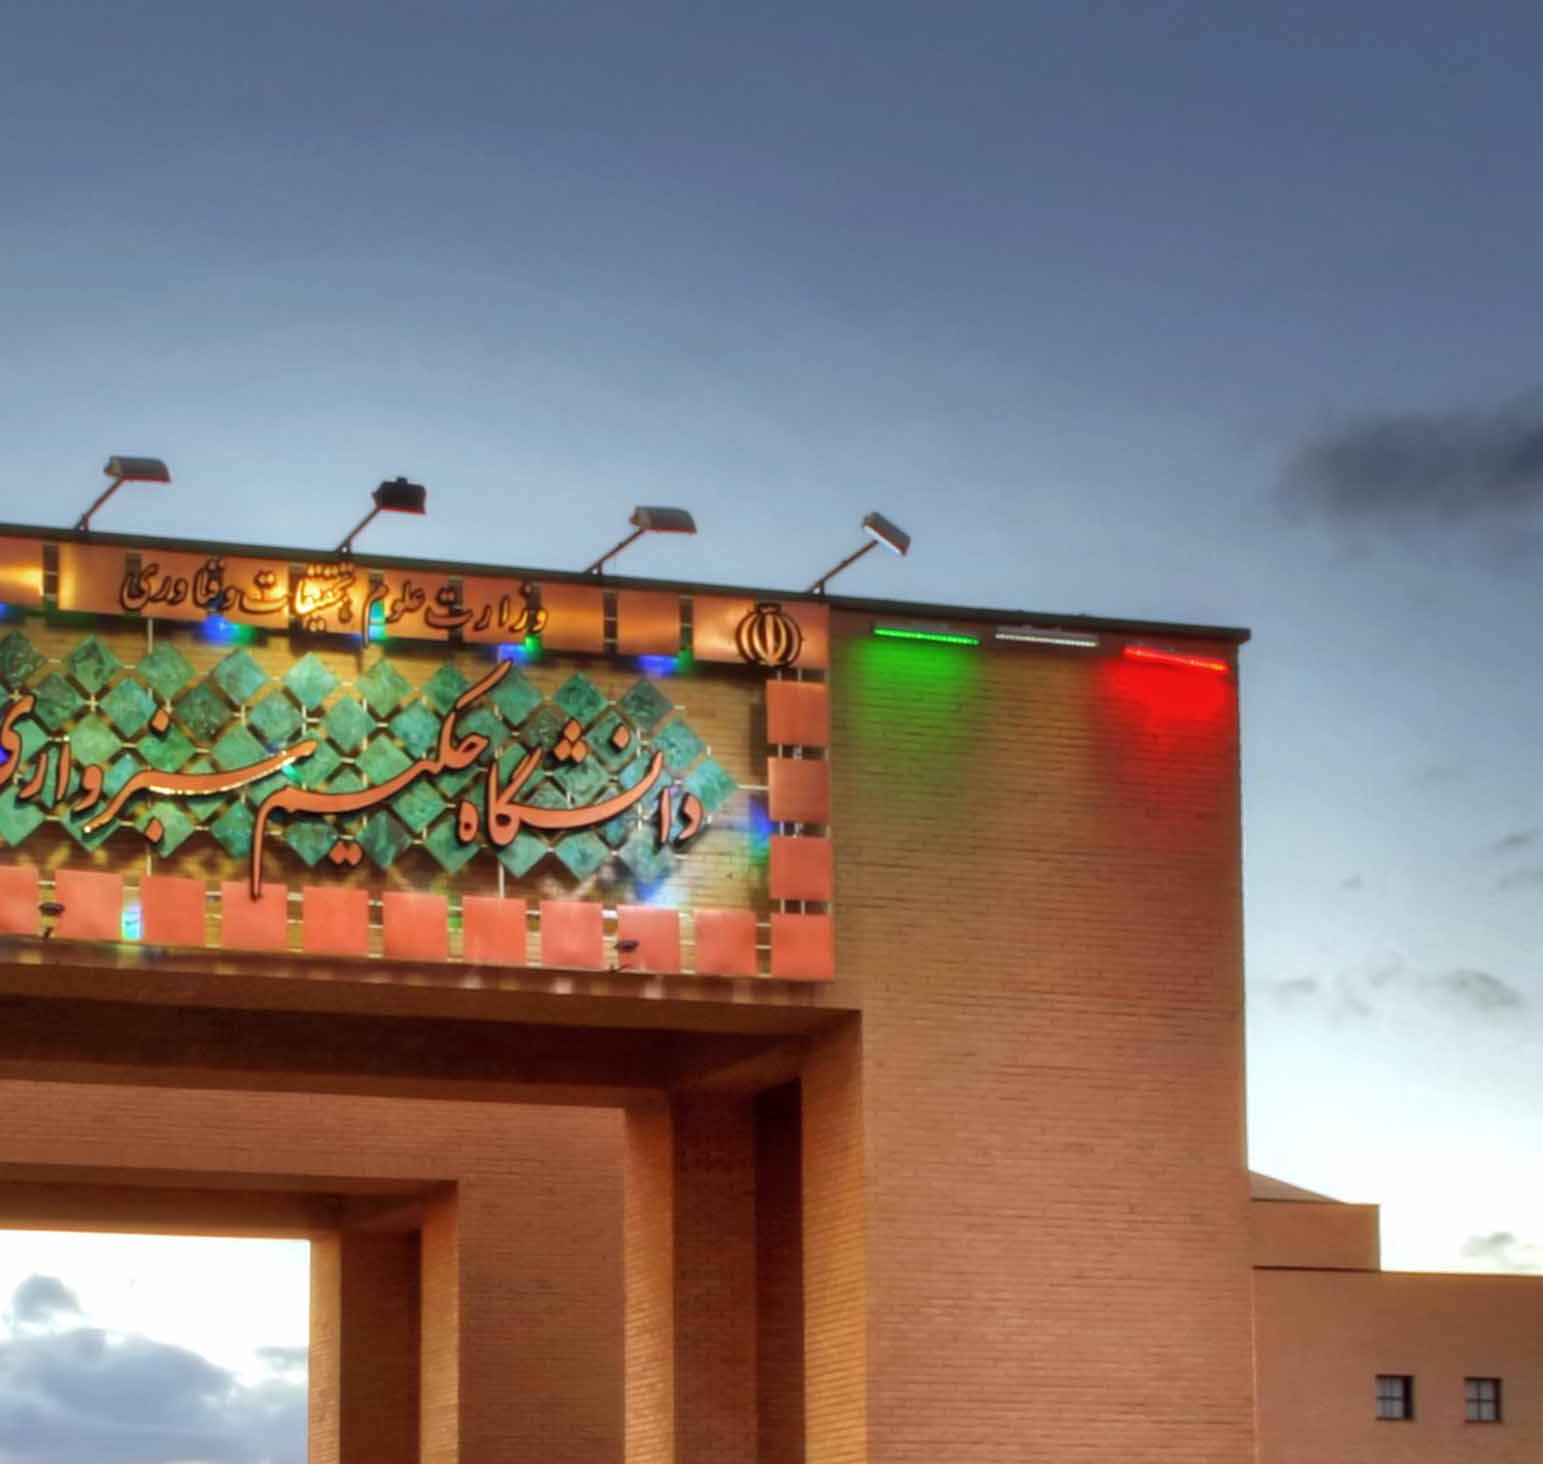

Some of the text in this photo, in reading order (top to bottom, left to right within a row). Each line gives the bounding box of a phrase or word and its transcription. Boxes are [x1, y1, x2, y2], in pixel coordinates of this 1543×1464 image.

[361, 579, 426, 648] علوم
[424, 578, 548, 633] وزارت
[251, 658, 513, 900] حکیم
[458, 718, 704, 847] دانشگاه
